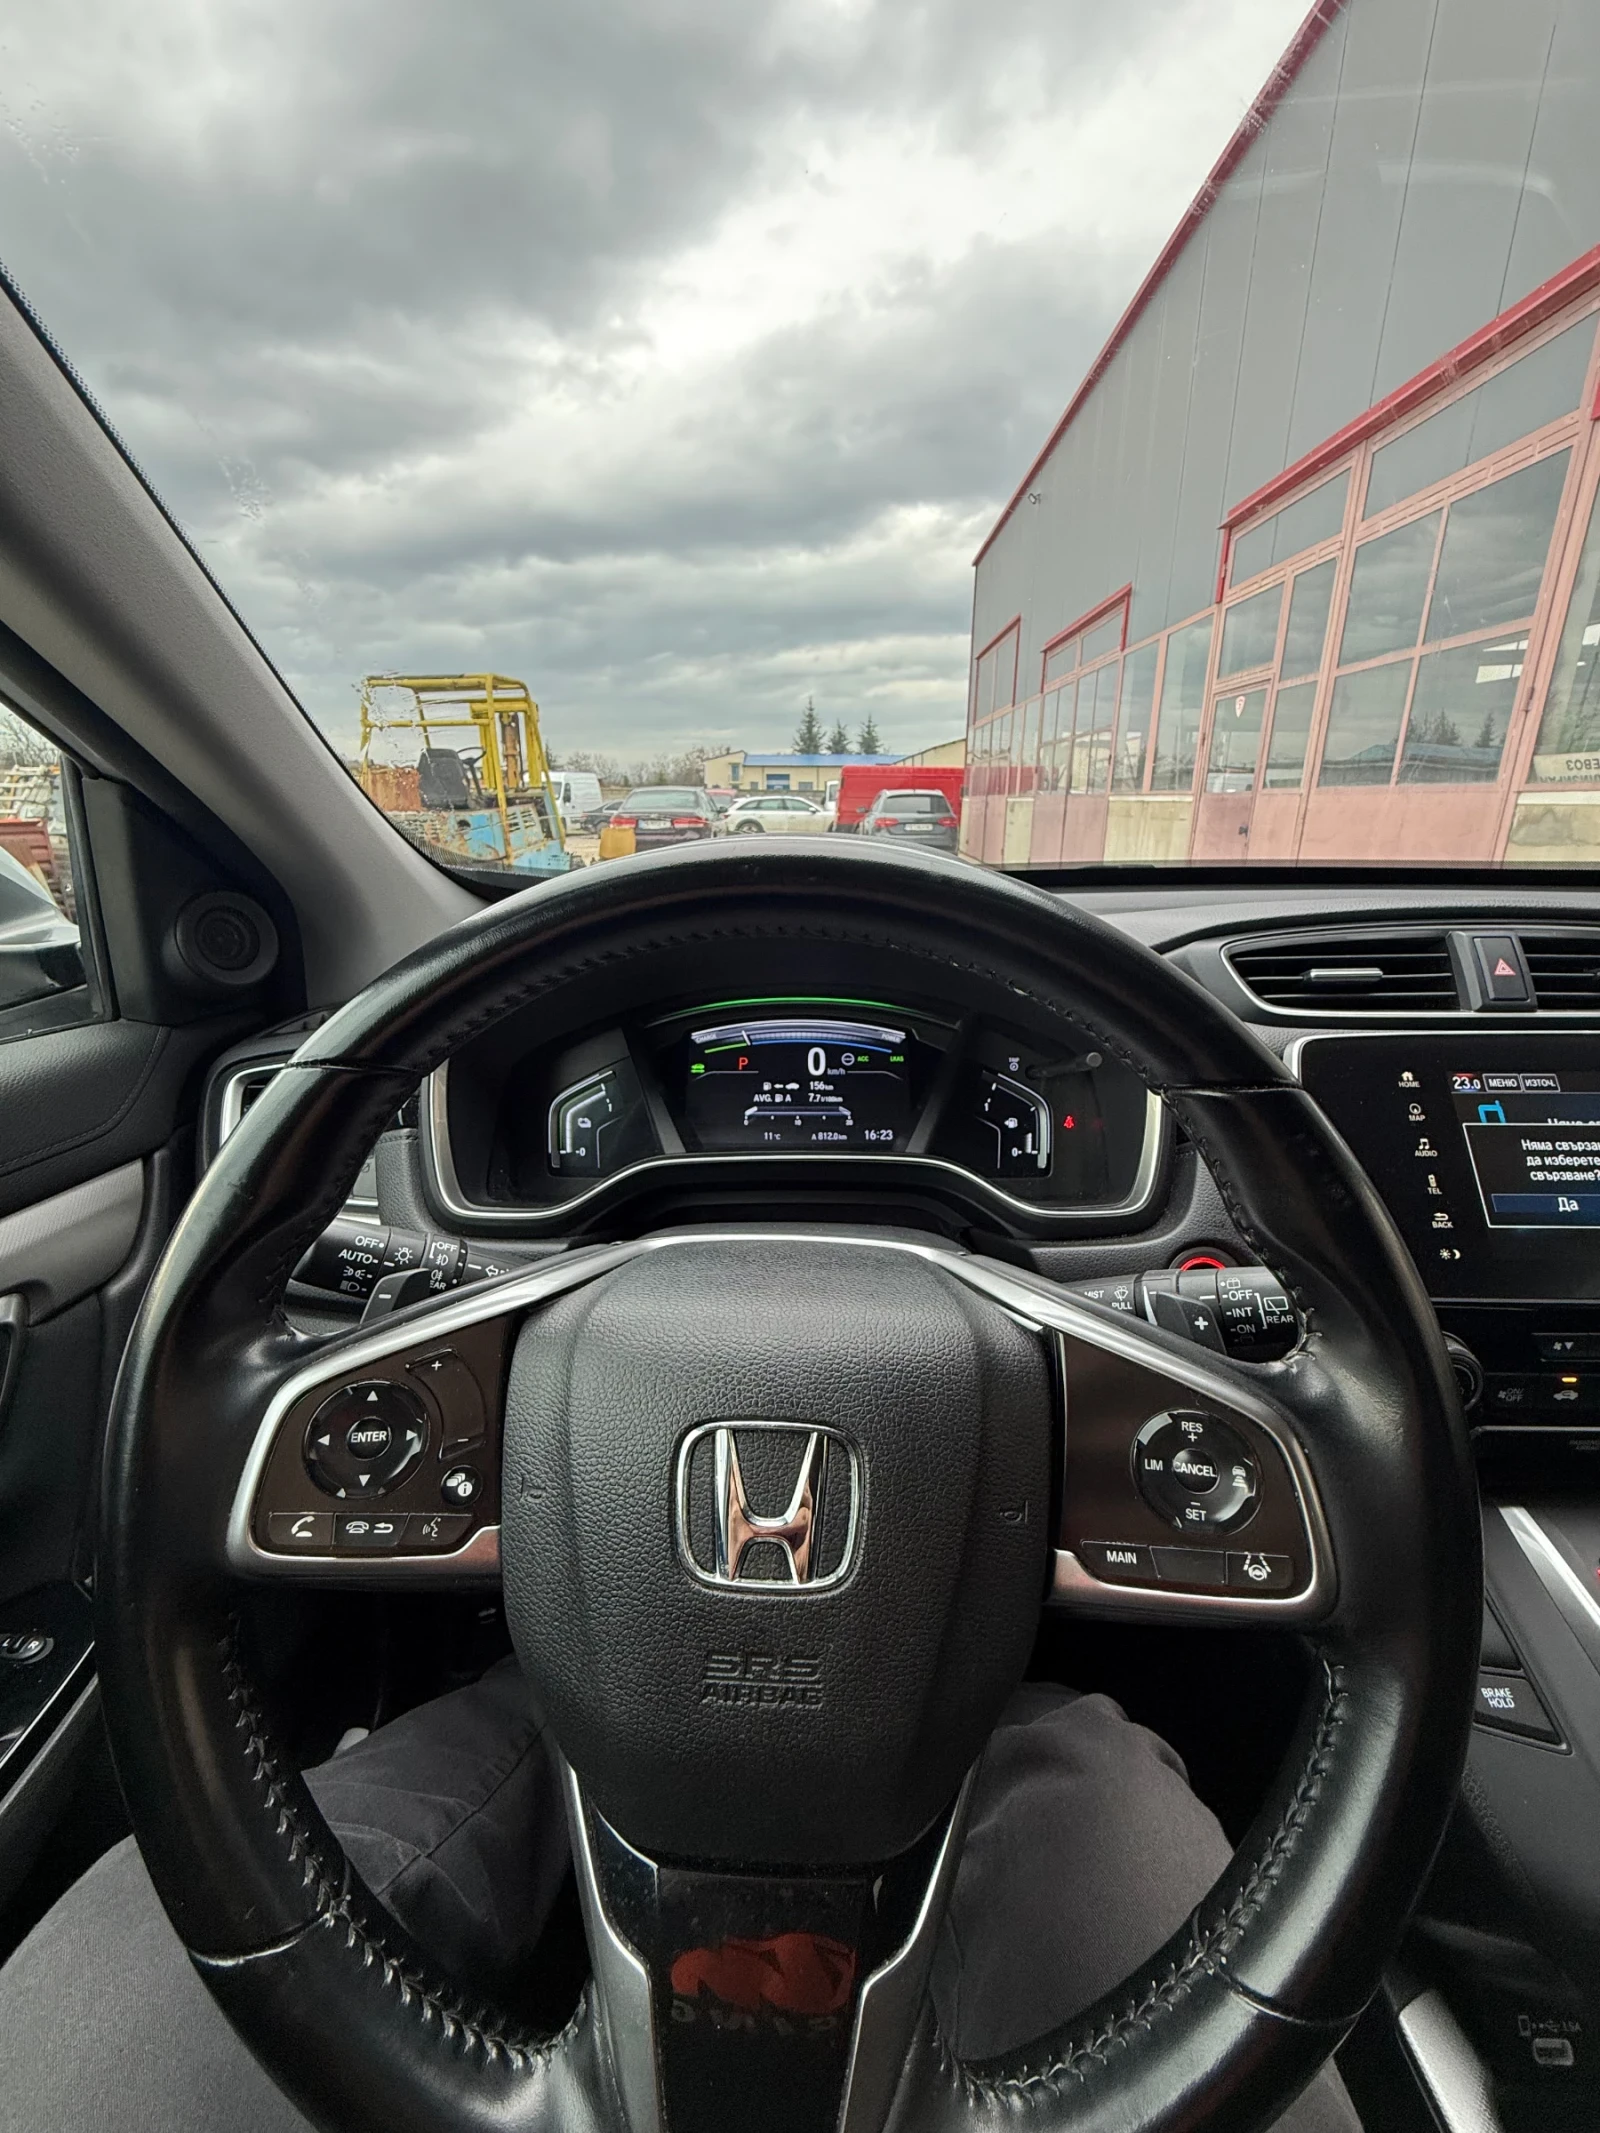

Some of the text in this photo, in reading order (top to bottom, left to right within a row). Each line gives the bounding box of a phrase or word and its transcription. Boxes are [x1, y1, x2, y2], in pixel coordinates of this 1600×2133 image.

[738, 1057, 748, 1070] P
[807, 1047, 846, 1076] 0 km/h
[1452, 1076, 1481, 1090] 23.0
[1488, 1078, 1518, 1088] МЕНЮ
[864, 1129, 893, 1141] 16:23
[1521, 1139, 1600, 1152] Няма свърза
[1526, 1156, 1542, 1166] да
[1427, 1187, 1442, 1195] TEL
[1558, 1197, 1579, 1212] Да
[355, 1236, 379, 1249] OFF
[437, 1241, 458, 1252] OFF
[338, 1249, 373, 1264] AUTO
[1229, 1290, 1253, 1301] OFF
[1112, 1301, 1133, 1310] PULL
[1232, 1307, 1252, 1318] INT
[1266, 1315, 1294, 1324] REAR
[1237, 1324, 1256, 1334] ON
[1181, 1421, 1203, 1433] RES
[350, 1430, 387, 1443] ENTER
[1144, 1459, 1217, 1477] LIM CANCEL
[1185, 1508, 1207, 1521] SET
[1106, 1550, 1137, 1564] MAIN
[704, 1653, 822, 1682] SRS
[701, 1684, 824, 1710] AIRBAG
[1481, 1687, 1513, 1698] BRAKE
[1488, 1698, 1515, 1708] HOLD
